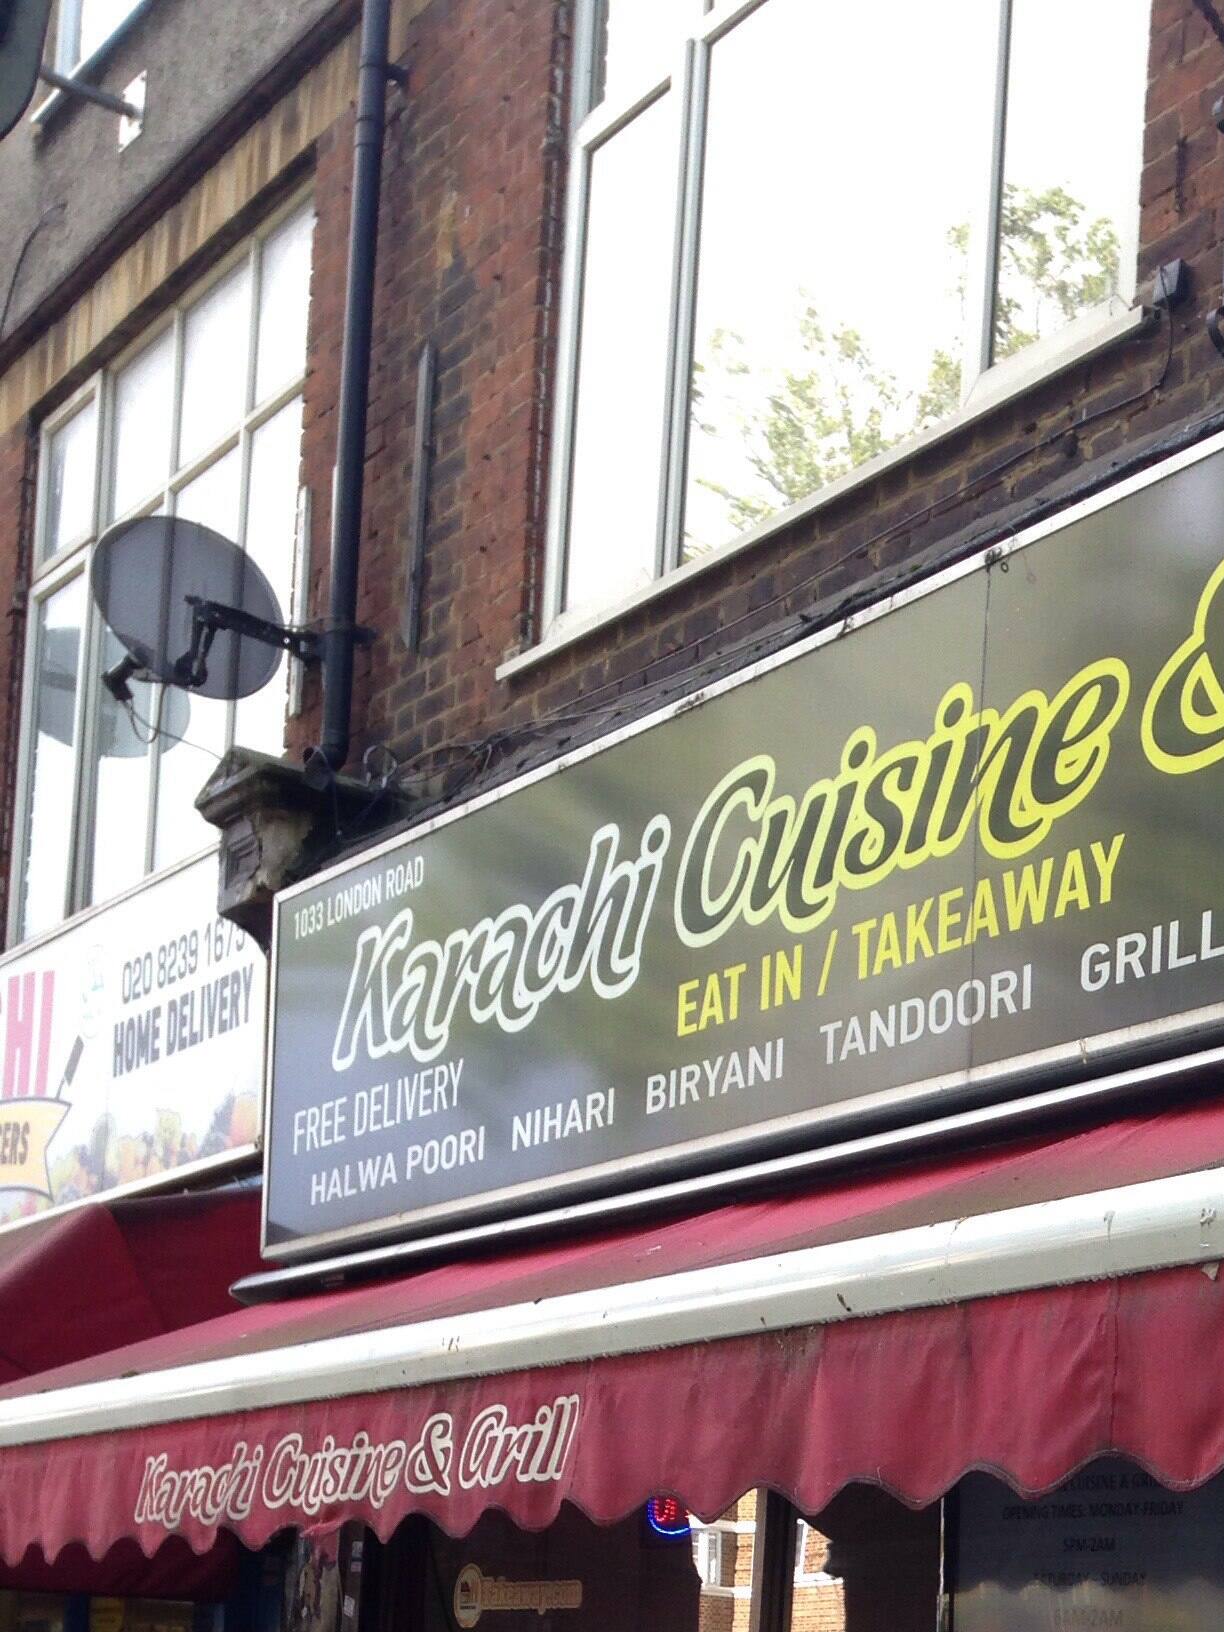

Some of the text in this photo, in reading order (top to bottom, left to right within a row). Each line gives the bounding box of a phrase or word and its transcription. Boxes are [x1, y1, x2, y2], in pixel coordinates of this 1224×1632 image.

[294, 855, 424, 940] 1033 LONDON ROAD
[331, 813, 671, 1073] Karachi
[673, 656, 1131, 949] Cuisine
[121, 951, 153, 1005] 020
[156, 931, 199, 989] 8239
[676, 833, 1127, 1038] EAT IN / TAKEAWAY
[0, 969, 56, 1100] HI
[113, 962, 255, 1079] HOME DELIVERY
[0, 1120, 31, 1166] ERS
[292, 1056, 465, 1155] FREE DELIVERY
[310, 1151, 398, 1206] HALWA
[405, 1125, 486, 1181] POORI
[511, 1086, 616, 1152] NIHARI
[645, 1037, 785, 1115] BIRYANI
[819, 962, 1034, 1065] TANDOORI
[134, 1394, 581, 1530] Karachi Cuisine & Grill
